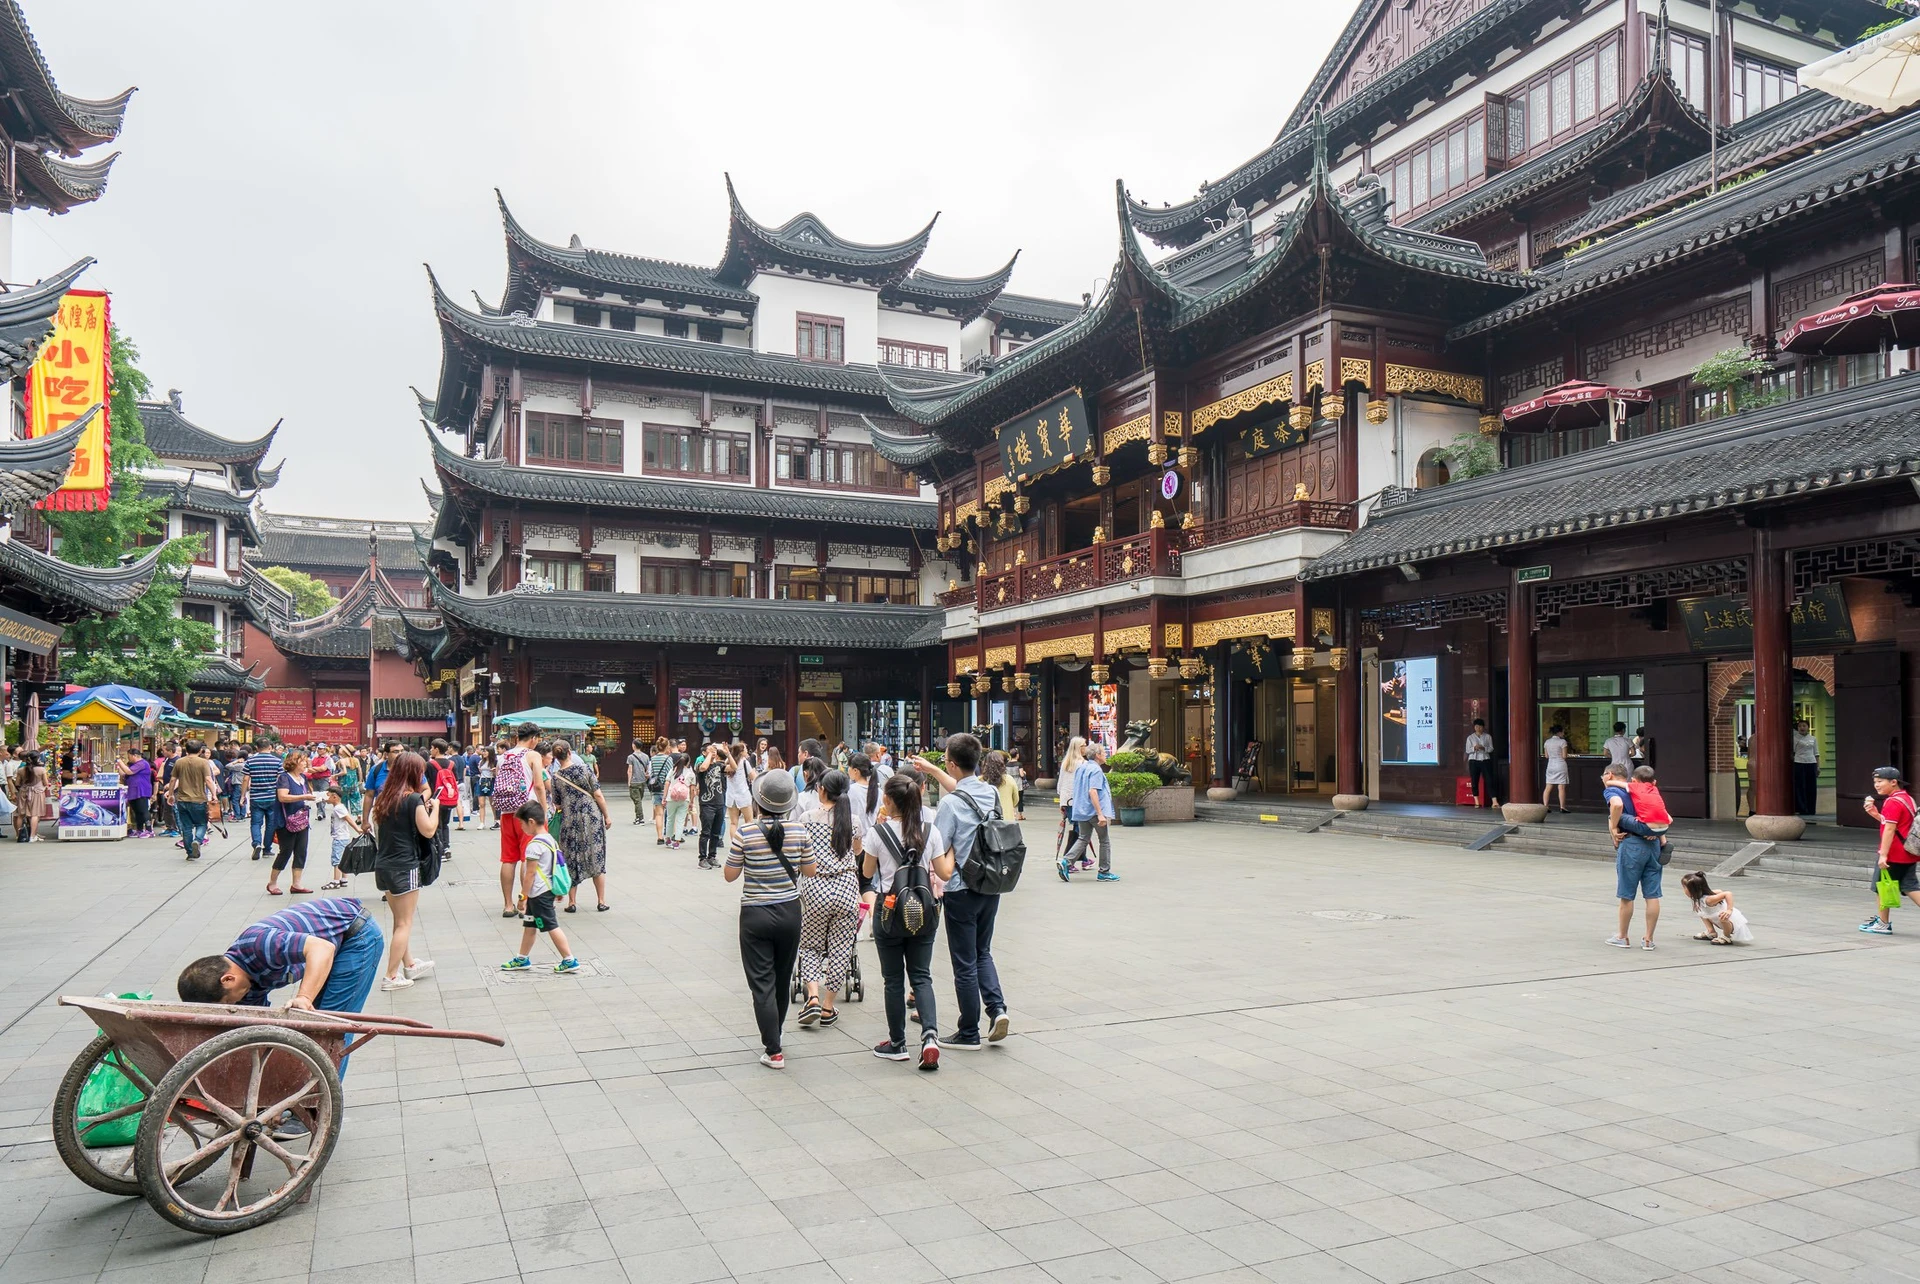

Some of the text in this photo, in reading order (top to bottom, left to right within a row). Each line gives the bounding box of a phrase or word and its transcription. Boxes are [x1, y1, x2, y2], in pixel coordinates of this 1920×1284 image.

[1894, 295, 1918, 308] Tea
[30, 629, 57, 648] COFFEE
[194, 696, 231, 704] 百年老店
[324, 709, 347, 717] 入口
